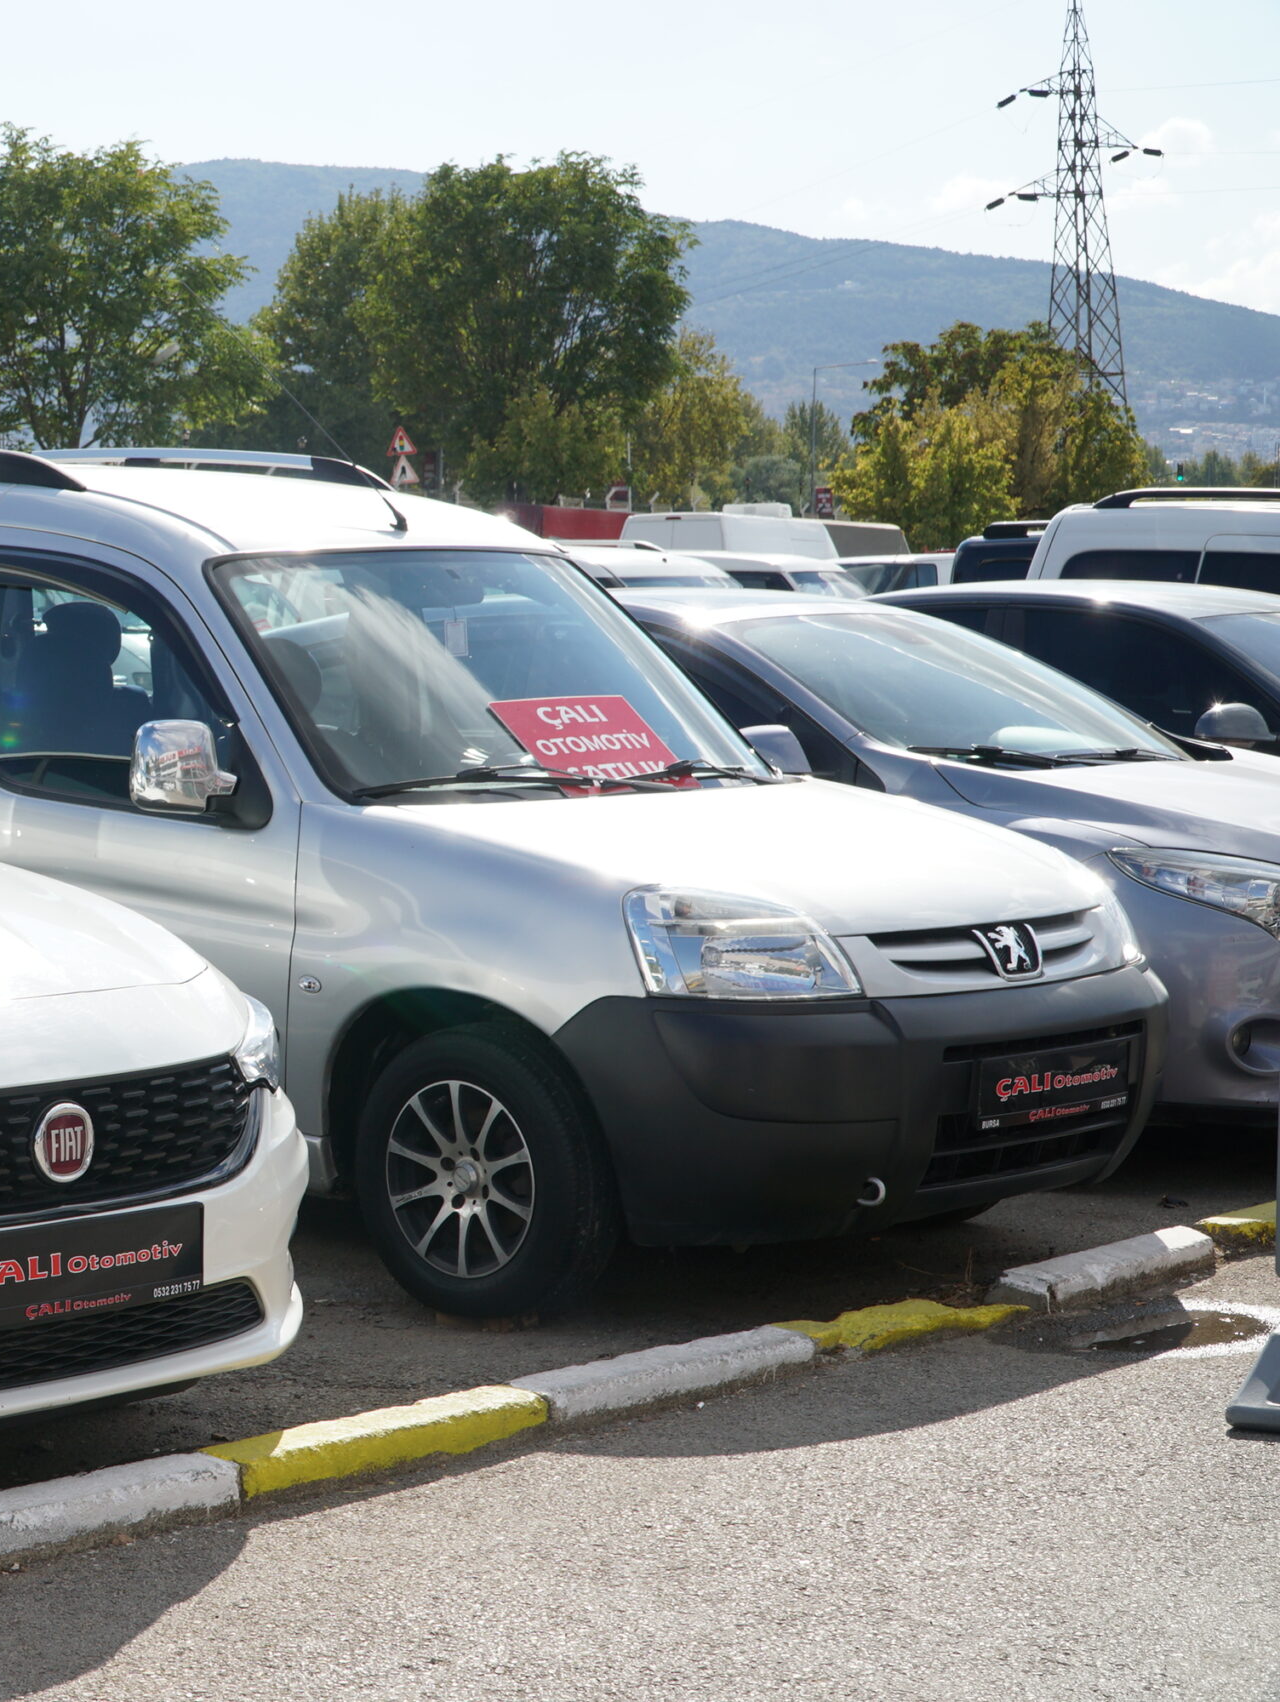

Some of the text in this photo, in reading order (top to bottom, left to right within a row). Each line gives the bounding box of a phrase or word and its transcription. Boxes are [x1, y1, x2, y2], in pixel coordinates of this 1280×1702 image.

[536, 704, 609, 730] ÇALI
[536, 729, 651, 756] OTOMOTİV
[995, 1065, 1118, 1102] ÇALI Otomotiv
[51, 1126, 83, 1163] FIAT
[67, 1240, 183, 1273] Otomotiv
[153, 1279, 200, 1298] 0532 231 75 77
[24, 1292, 132, 1320] ÇALI Otomotiv
